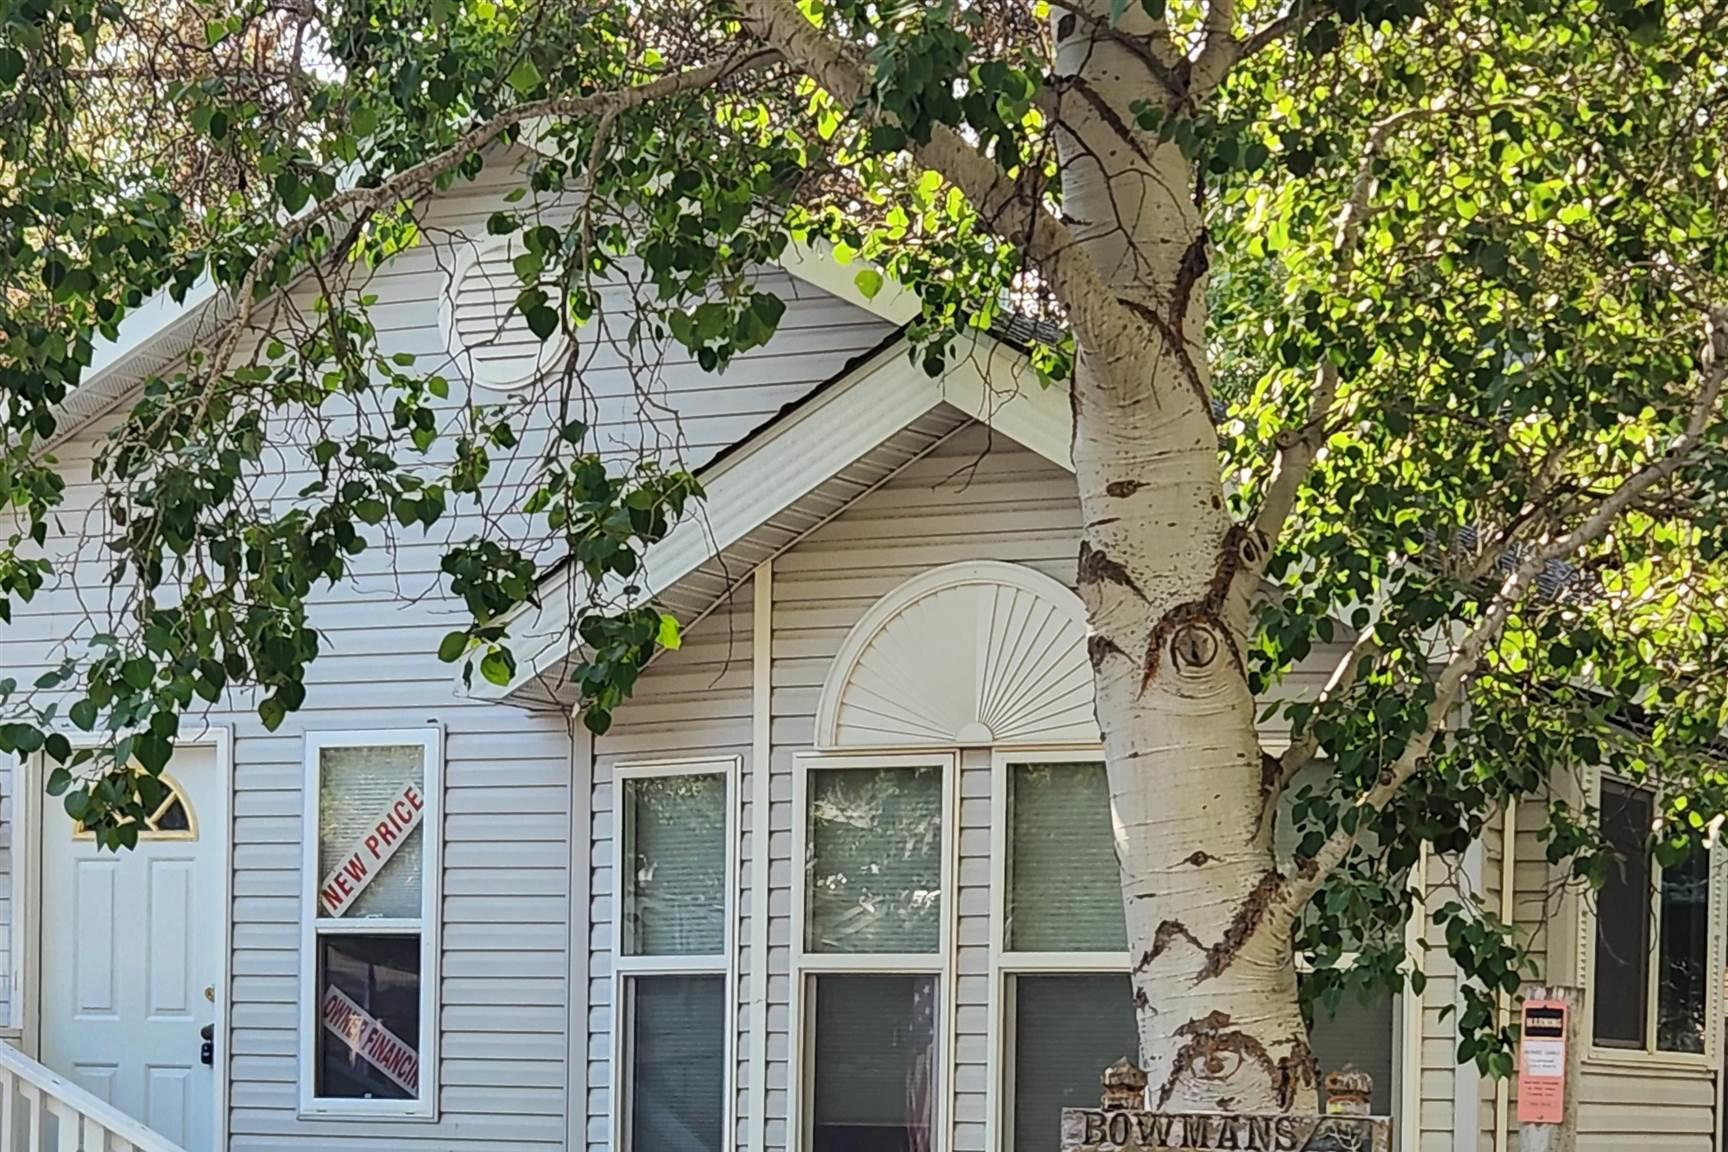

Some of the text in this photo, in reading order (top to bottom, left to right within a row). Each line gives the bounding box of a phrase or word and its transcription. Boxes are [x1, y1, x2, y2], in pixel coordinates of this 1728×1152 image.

[321, 786, 424, 911] NEW PRICE
[1082, 1111, 1298, 1150] BOWMANS
